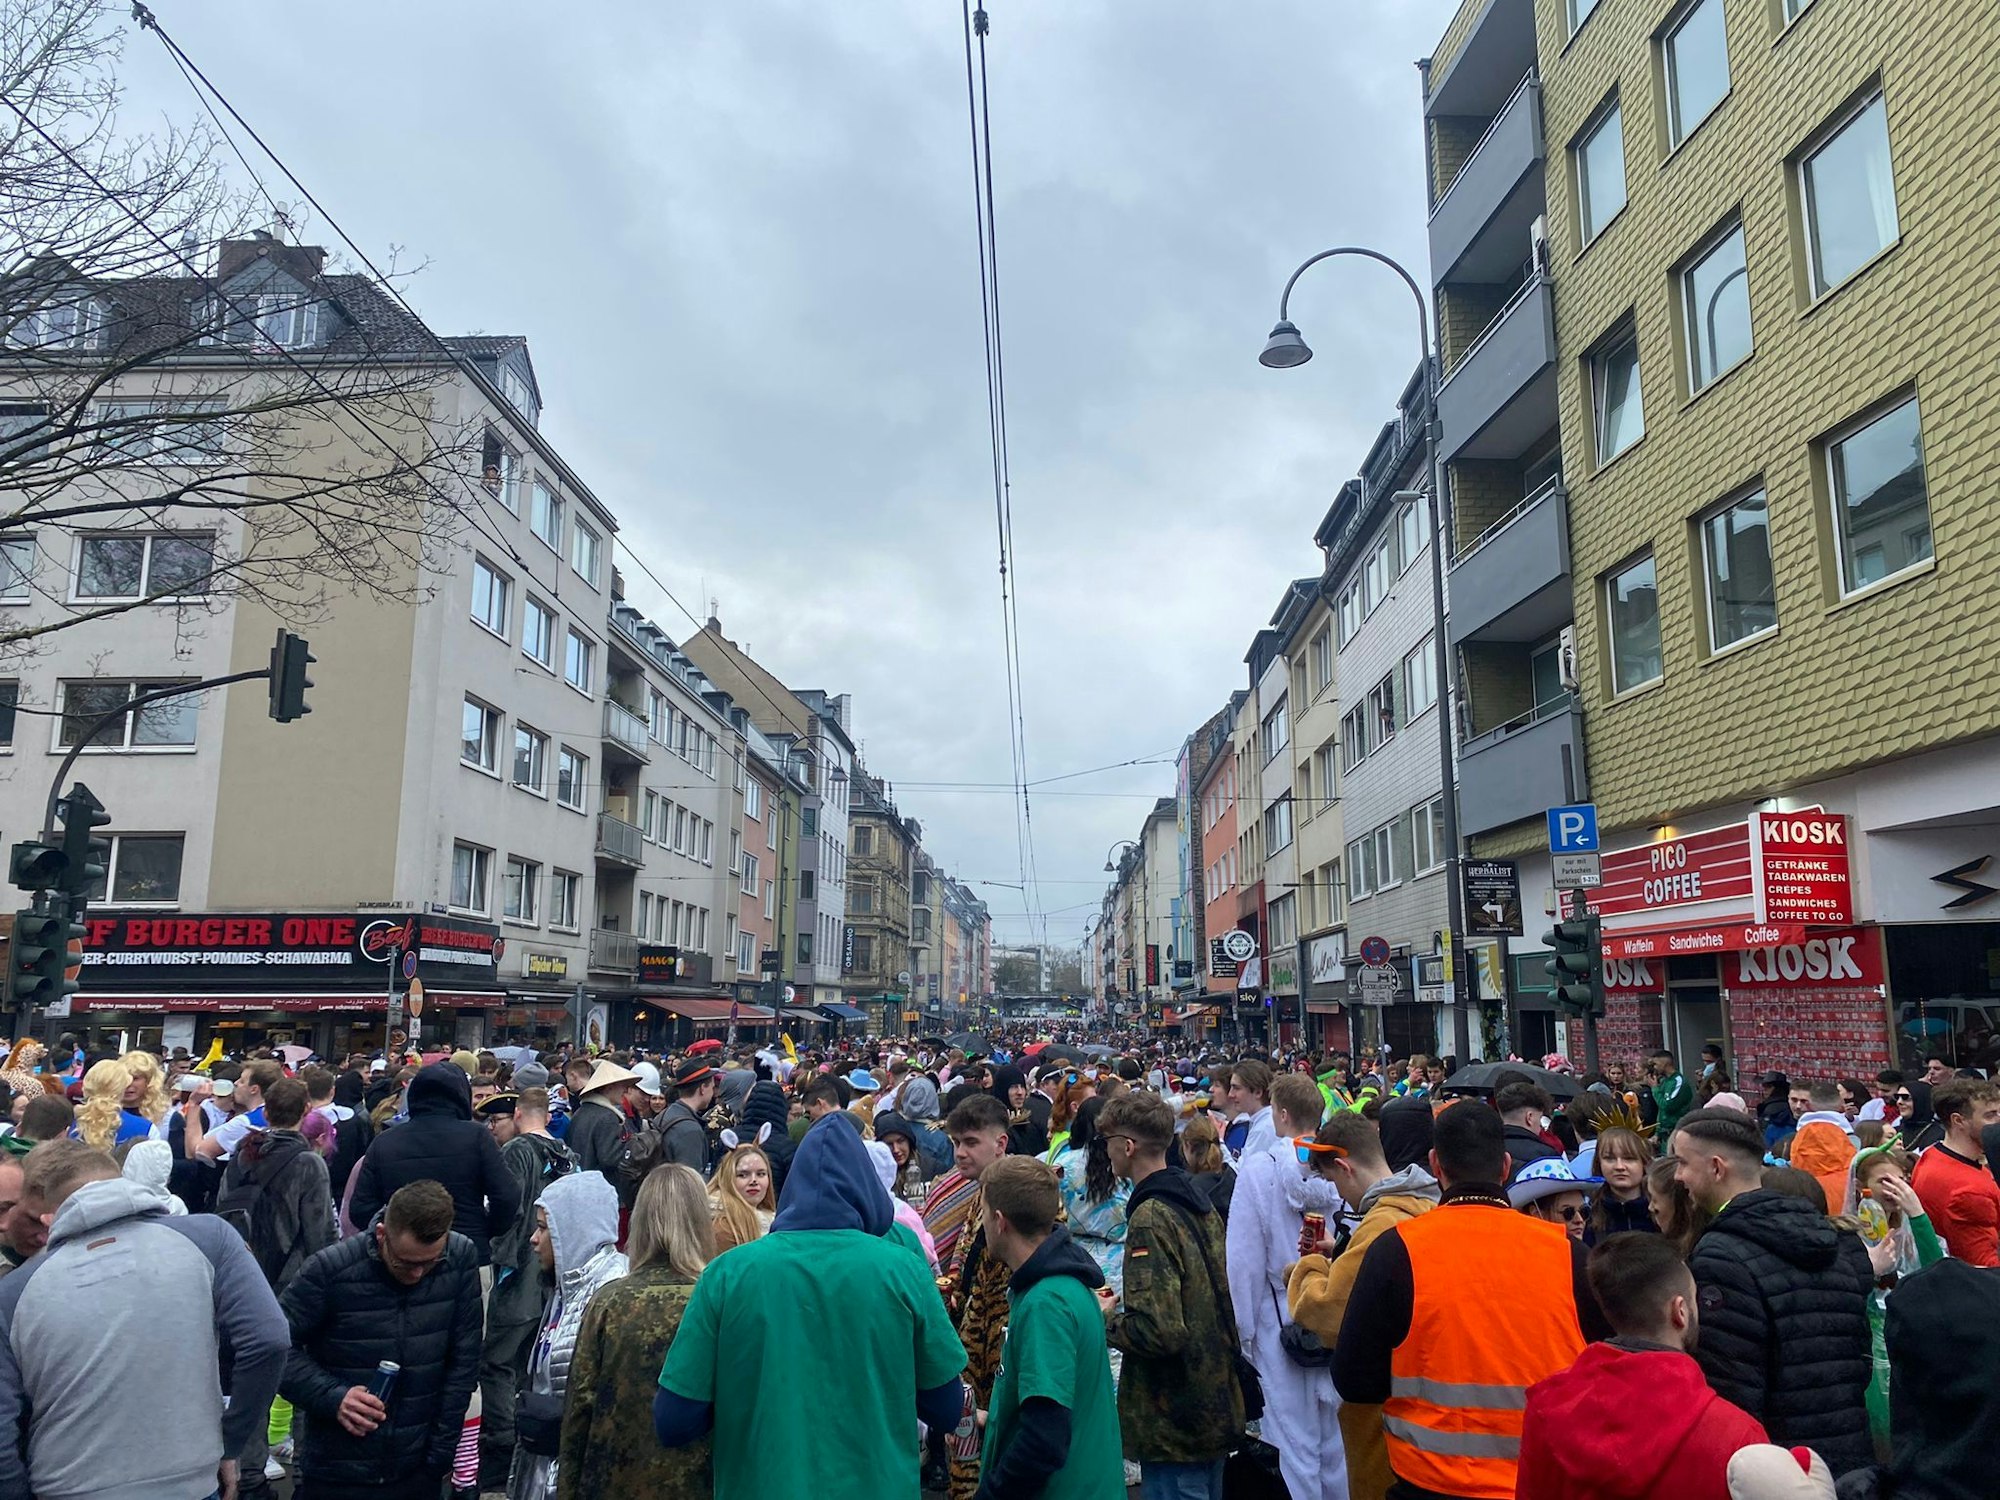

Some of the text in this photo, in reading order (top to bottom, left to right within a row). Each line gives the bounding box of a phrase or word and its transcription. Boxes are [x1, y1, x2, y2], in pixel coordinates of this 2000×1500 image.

[1559, 812, 1585, 847] P
[1763, 820, 1843, 844] KIOSK
[1650, 843, 1687, 872] PICO
[1767, 859, 1829, 870] GETRÄNKE
[1468, 867, 1512, 876] HERBALIST
[1562, 866, 1592, 874] Parkschein
[1767, 872, 1846, 882] TABAKWAREN
[1557, 876, 1580, 884] werktags
[1643, 872, 1702, 904] COFFEE
[1769, 898, 1837, 908] SANDWICHES
[1770, 911, 1844, 920] COFFEE TO GO
[125, 919, 272, 945] BURGER
[282, 919, 356, 945] ONE
[365, 917, 414, 951] Beef
[448, 930, 479, 949] BURGER
[1744, 928, 1780, 944] Coffee
[1624, 941, 1654, 953] Waffeln
[1669, 933, 1724, 950] Sandwiches
[82, 952, 353, 965] ER-CURRYWURST-POMMES-SCHAWARMA
[641, 956, 675, 965] MANGO
[1739, 936, 1863, 983] KIOSK
[1602, 958, 1654, 988] OSK
[1239, 992, 1257, 1004] sky
[903, 1181, 931, 1196] SWAT
